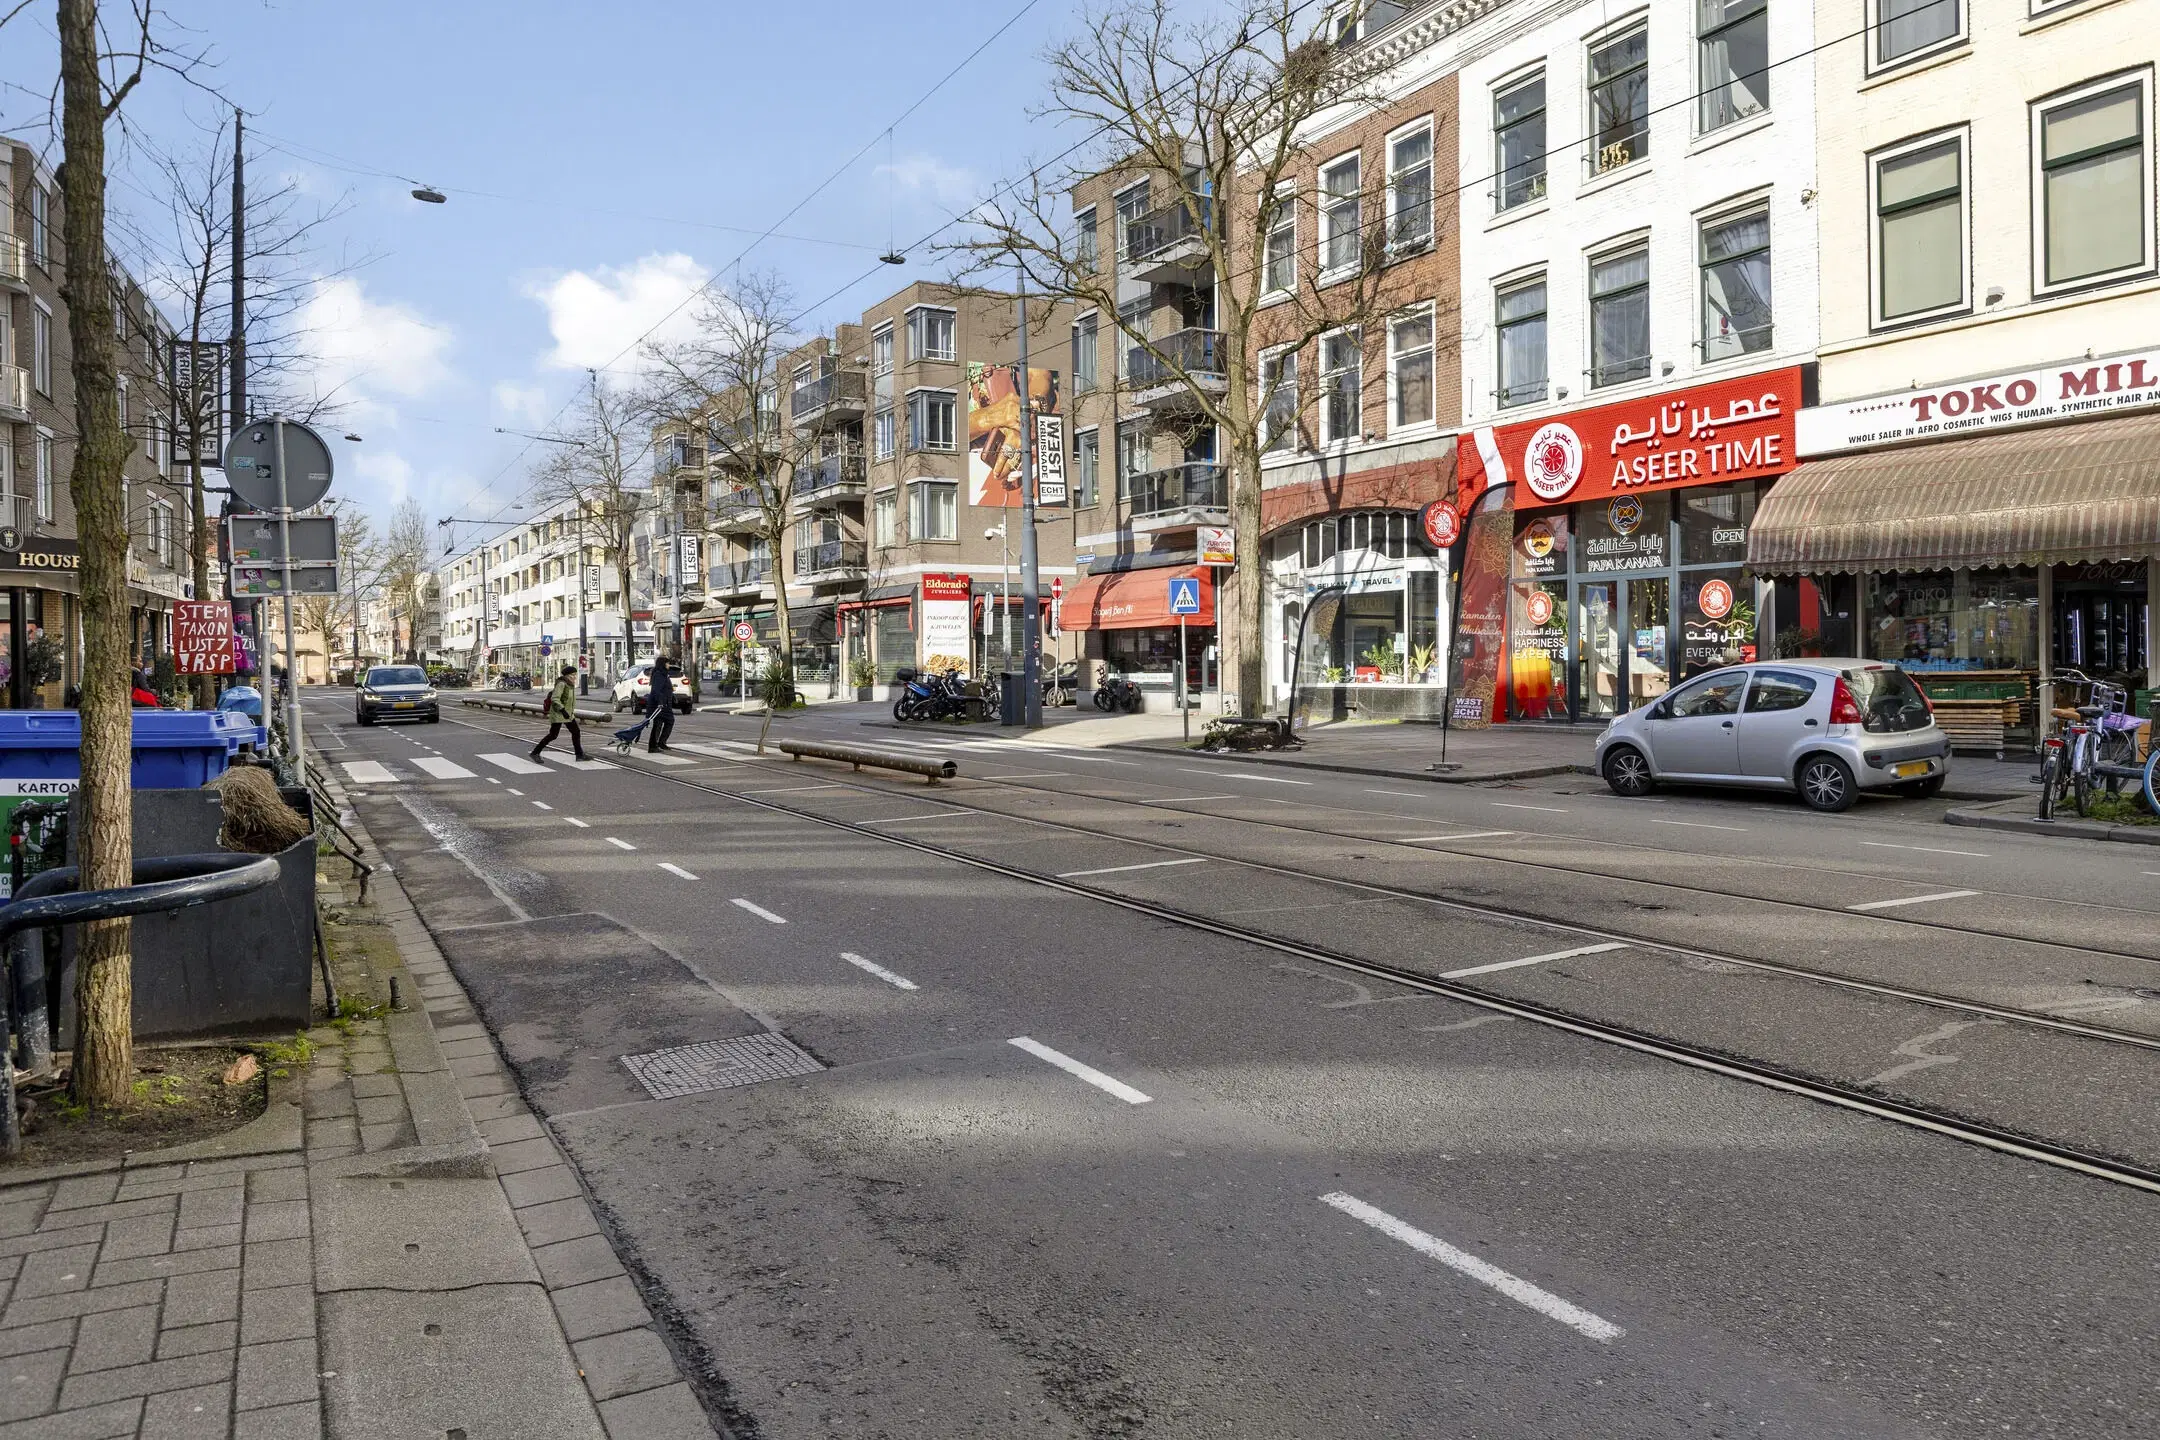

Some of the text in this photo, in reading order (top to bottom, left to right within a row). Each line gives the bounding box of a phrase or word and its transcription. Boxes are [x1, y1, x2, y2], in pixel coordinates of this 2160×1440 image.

[1909, 359, 2159, 422] TOKO MIL
[1610, 393, 1780, 455] عصير تايم
[1848, 433, 1876, 445] WHOLE
[1878, 429, 1902, 440] SALER
[1905, 428, 1914, 436] IN
[1917, 423, 1940, 435] AFRO
[1943, 416, 1985, 431] COSMETIC
[1990, 413, 2013, 424] WIGS
[2061, 396, 2113, 413] SYNTHETIC
[2116, 392, 2142, 404] HAIR
[1039, 420, 1049, 478] KRUISKADE
[1611, 434, 1781, 487] ASEER TIME
[1533, 472, 1573, 492] ASEER TIME
[1041, 486, 1064, 494] ECHT
[1714, 530, 1744, 542] OPEN
[1587, 555, 1664, 572] PAPA KANAFA
[925, 579, 968, 589] Eldorado
[1362, 577, 1393, 587] TRAVEL
[177, 604, 228, 620] STEM
[179, 621, 228, 637] TAXON
[1720, 628, 1745, 643] لكل
[216, 638, 228, 651] 7
[1514, 638, 1565, 648] HAPPINESS
[1514, 648, 1565, 659] EXPERTS
[1686, 647, 1718, 657] EVERY
